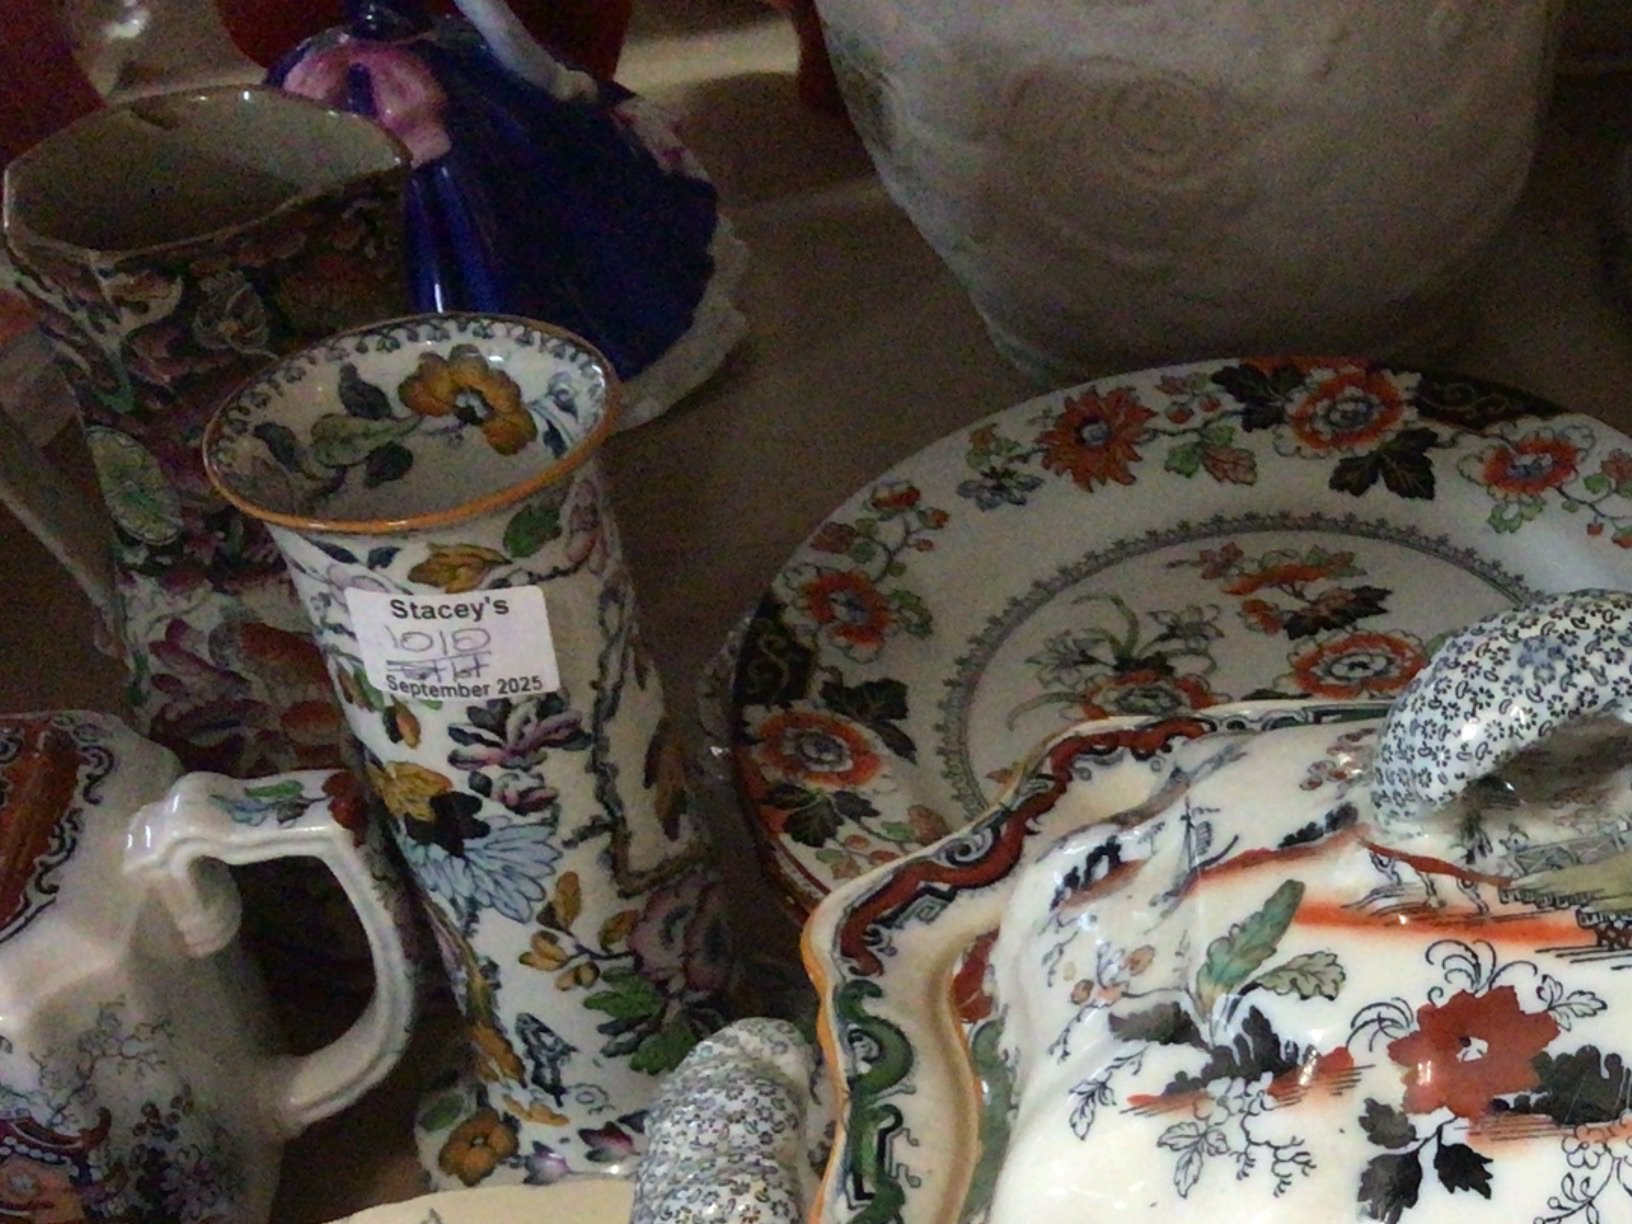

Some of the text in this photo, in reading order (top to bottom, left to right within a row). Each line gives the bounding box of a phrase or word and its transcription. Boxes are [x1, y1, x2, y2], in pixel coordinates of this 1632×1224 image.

[390, 596, 509, 622] Stacey's
[386, 675, 543, 698] September 2025
